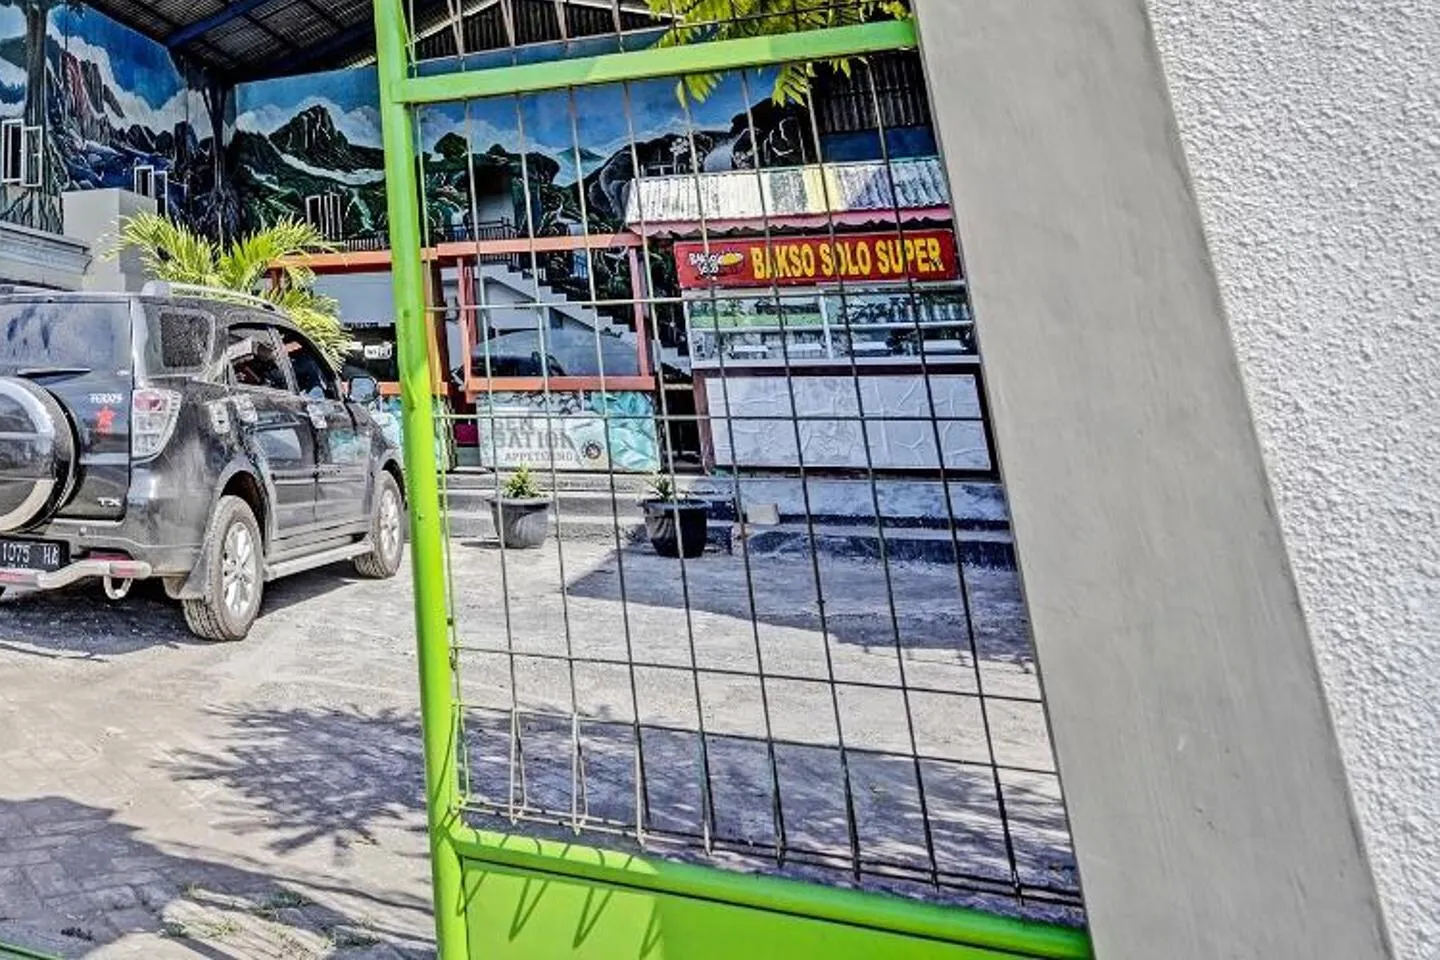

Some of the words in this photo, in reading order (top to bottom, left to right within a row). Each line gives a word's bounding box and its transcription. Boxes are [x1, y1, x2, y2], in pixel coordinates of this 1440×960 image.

[750, 243, 815, 280] BAKSO
[821, 240, 870, 278] SOLO
[875, 237, 945, 274] SUPER
